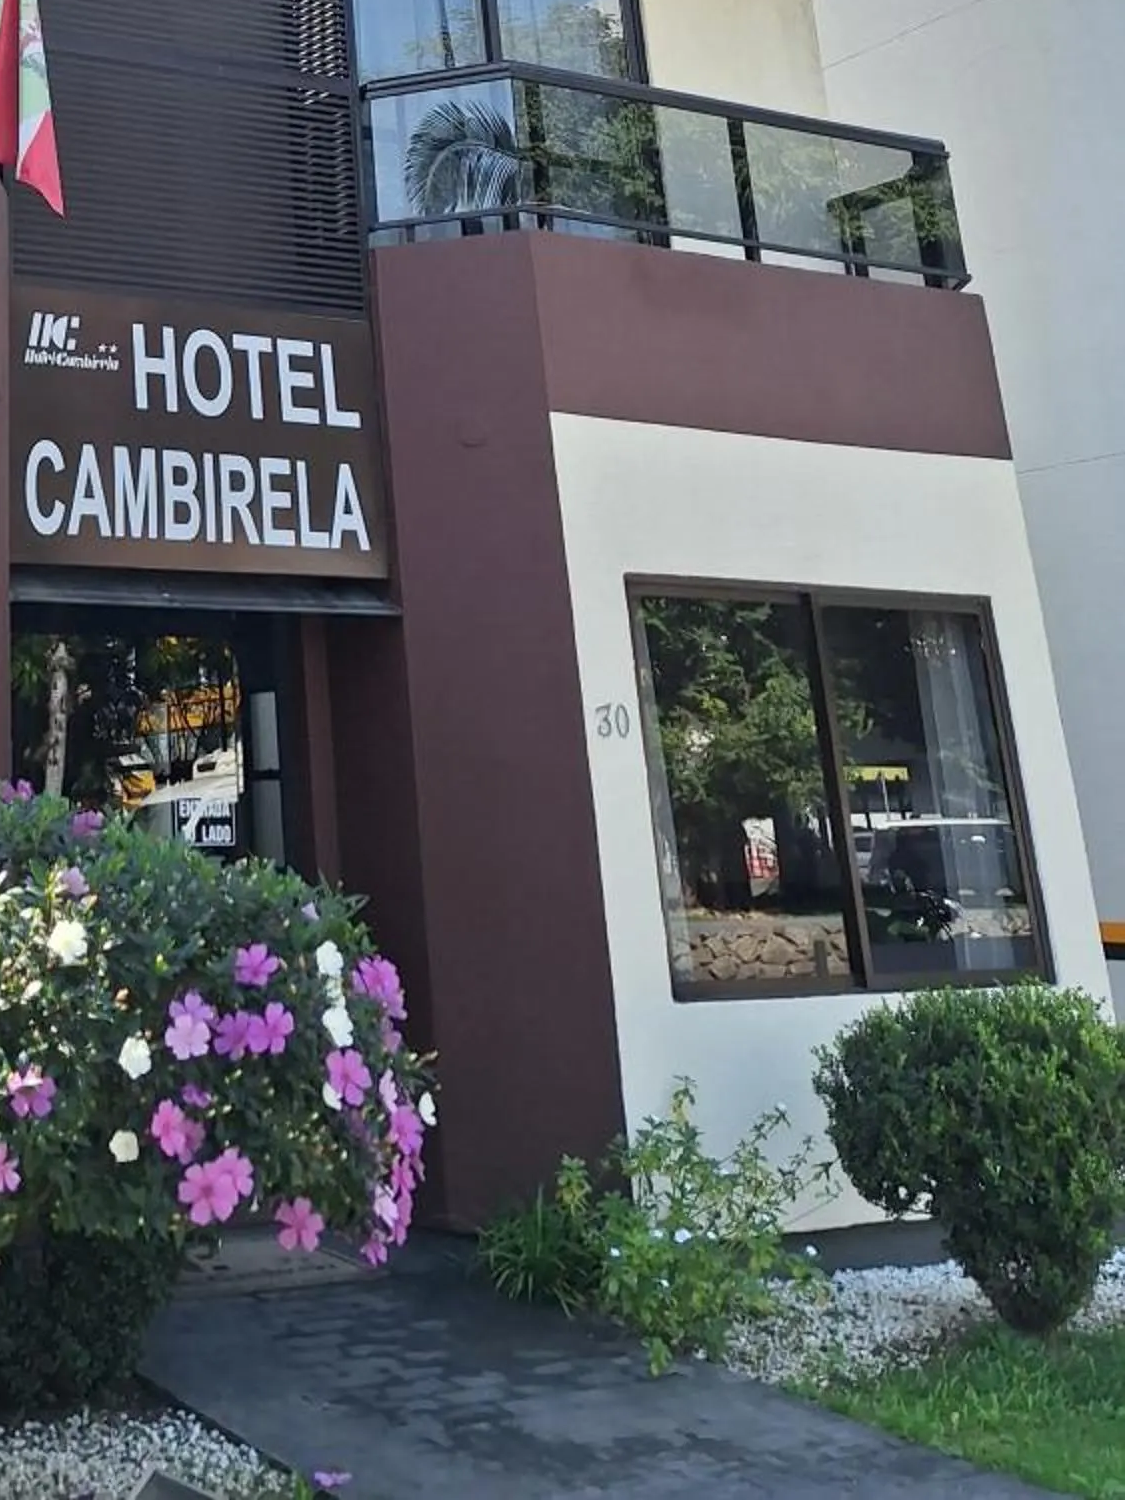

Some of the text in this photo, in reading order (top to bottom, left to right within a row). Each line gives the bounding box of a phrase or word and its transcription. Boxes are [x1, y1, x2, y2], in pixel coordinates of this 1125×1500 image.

[132, 323, 362, 428] HOTEL
[24, 439, 370, 550] CAMBIRELA
[595, 703, 629, 739] 30
[202, 825, 232, 841] LADO
